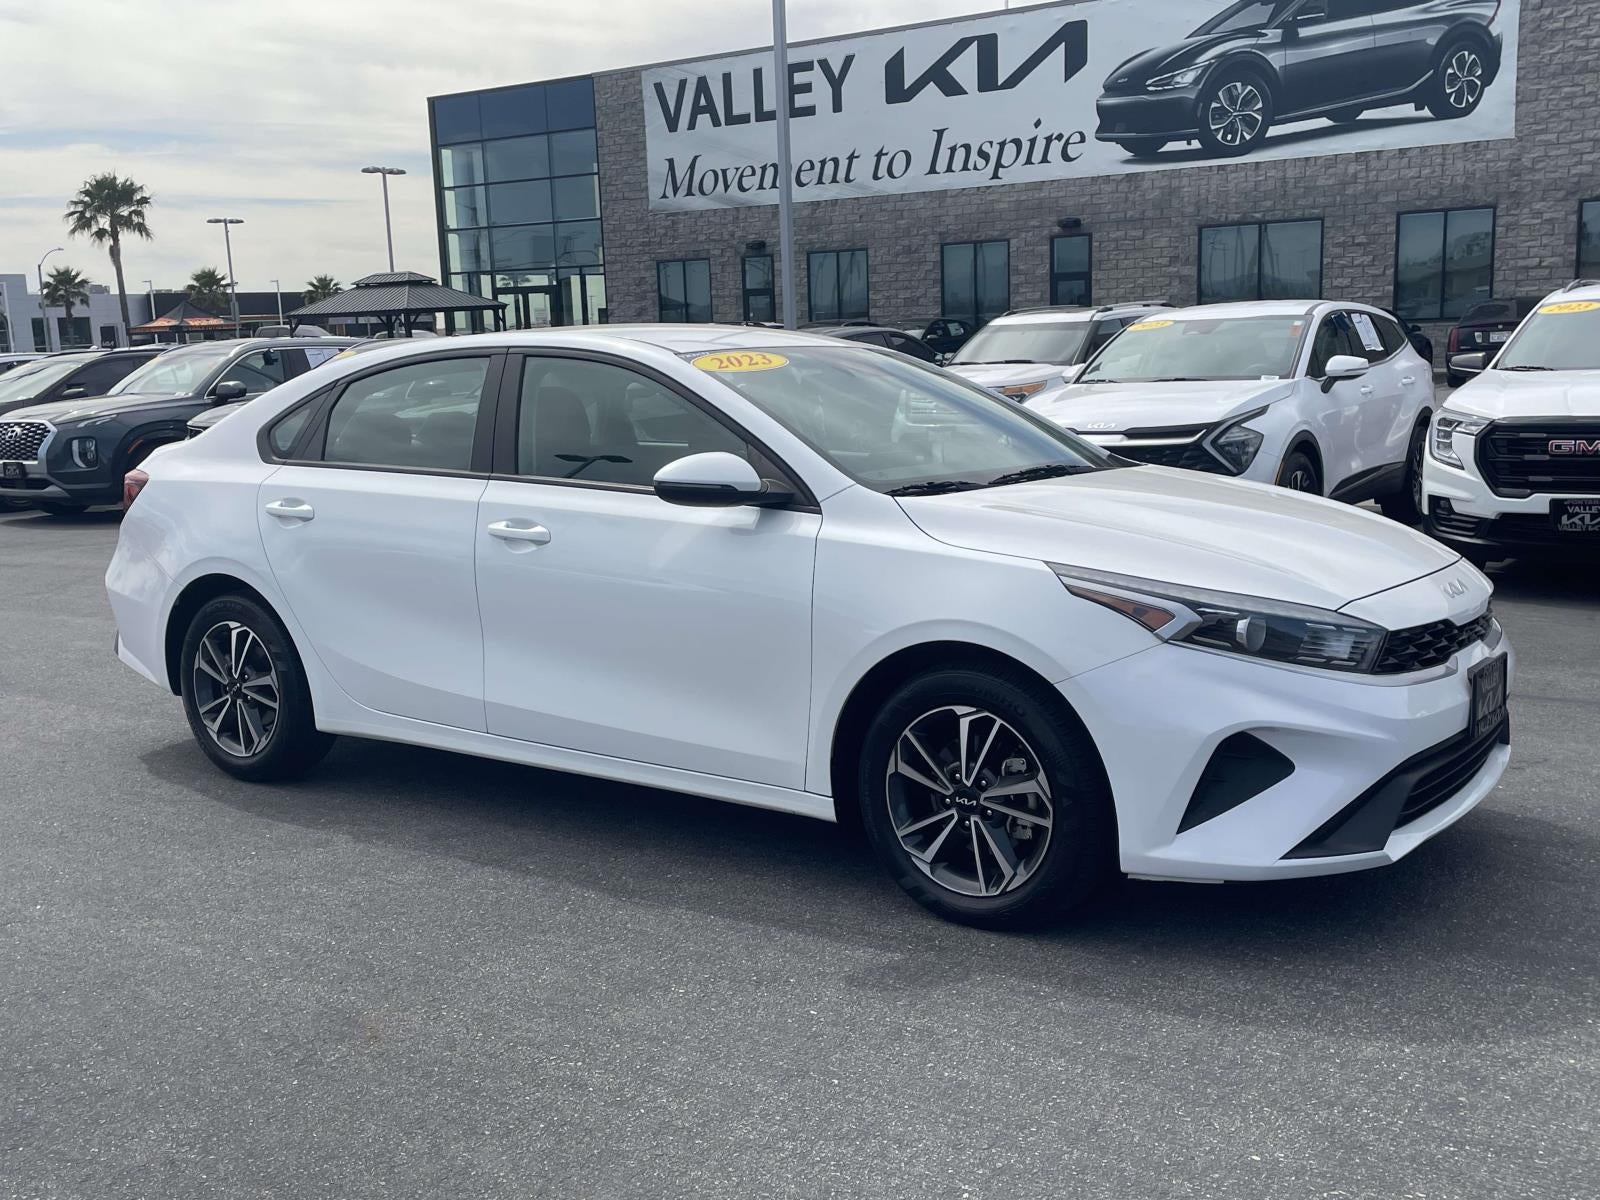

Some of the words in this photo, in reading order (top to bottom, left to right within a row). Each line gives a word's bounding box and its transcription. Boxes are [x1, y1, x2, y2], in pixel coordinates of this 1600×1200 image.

[653, 53, 856, 133] VALLEY
[884, 19, 1088, 105] KIA
[871, 145, 912, 181] to
[924, 117, 1087, 181] Inspire
[710, 353, 772, 369] 2023
